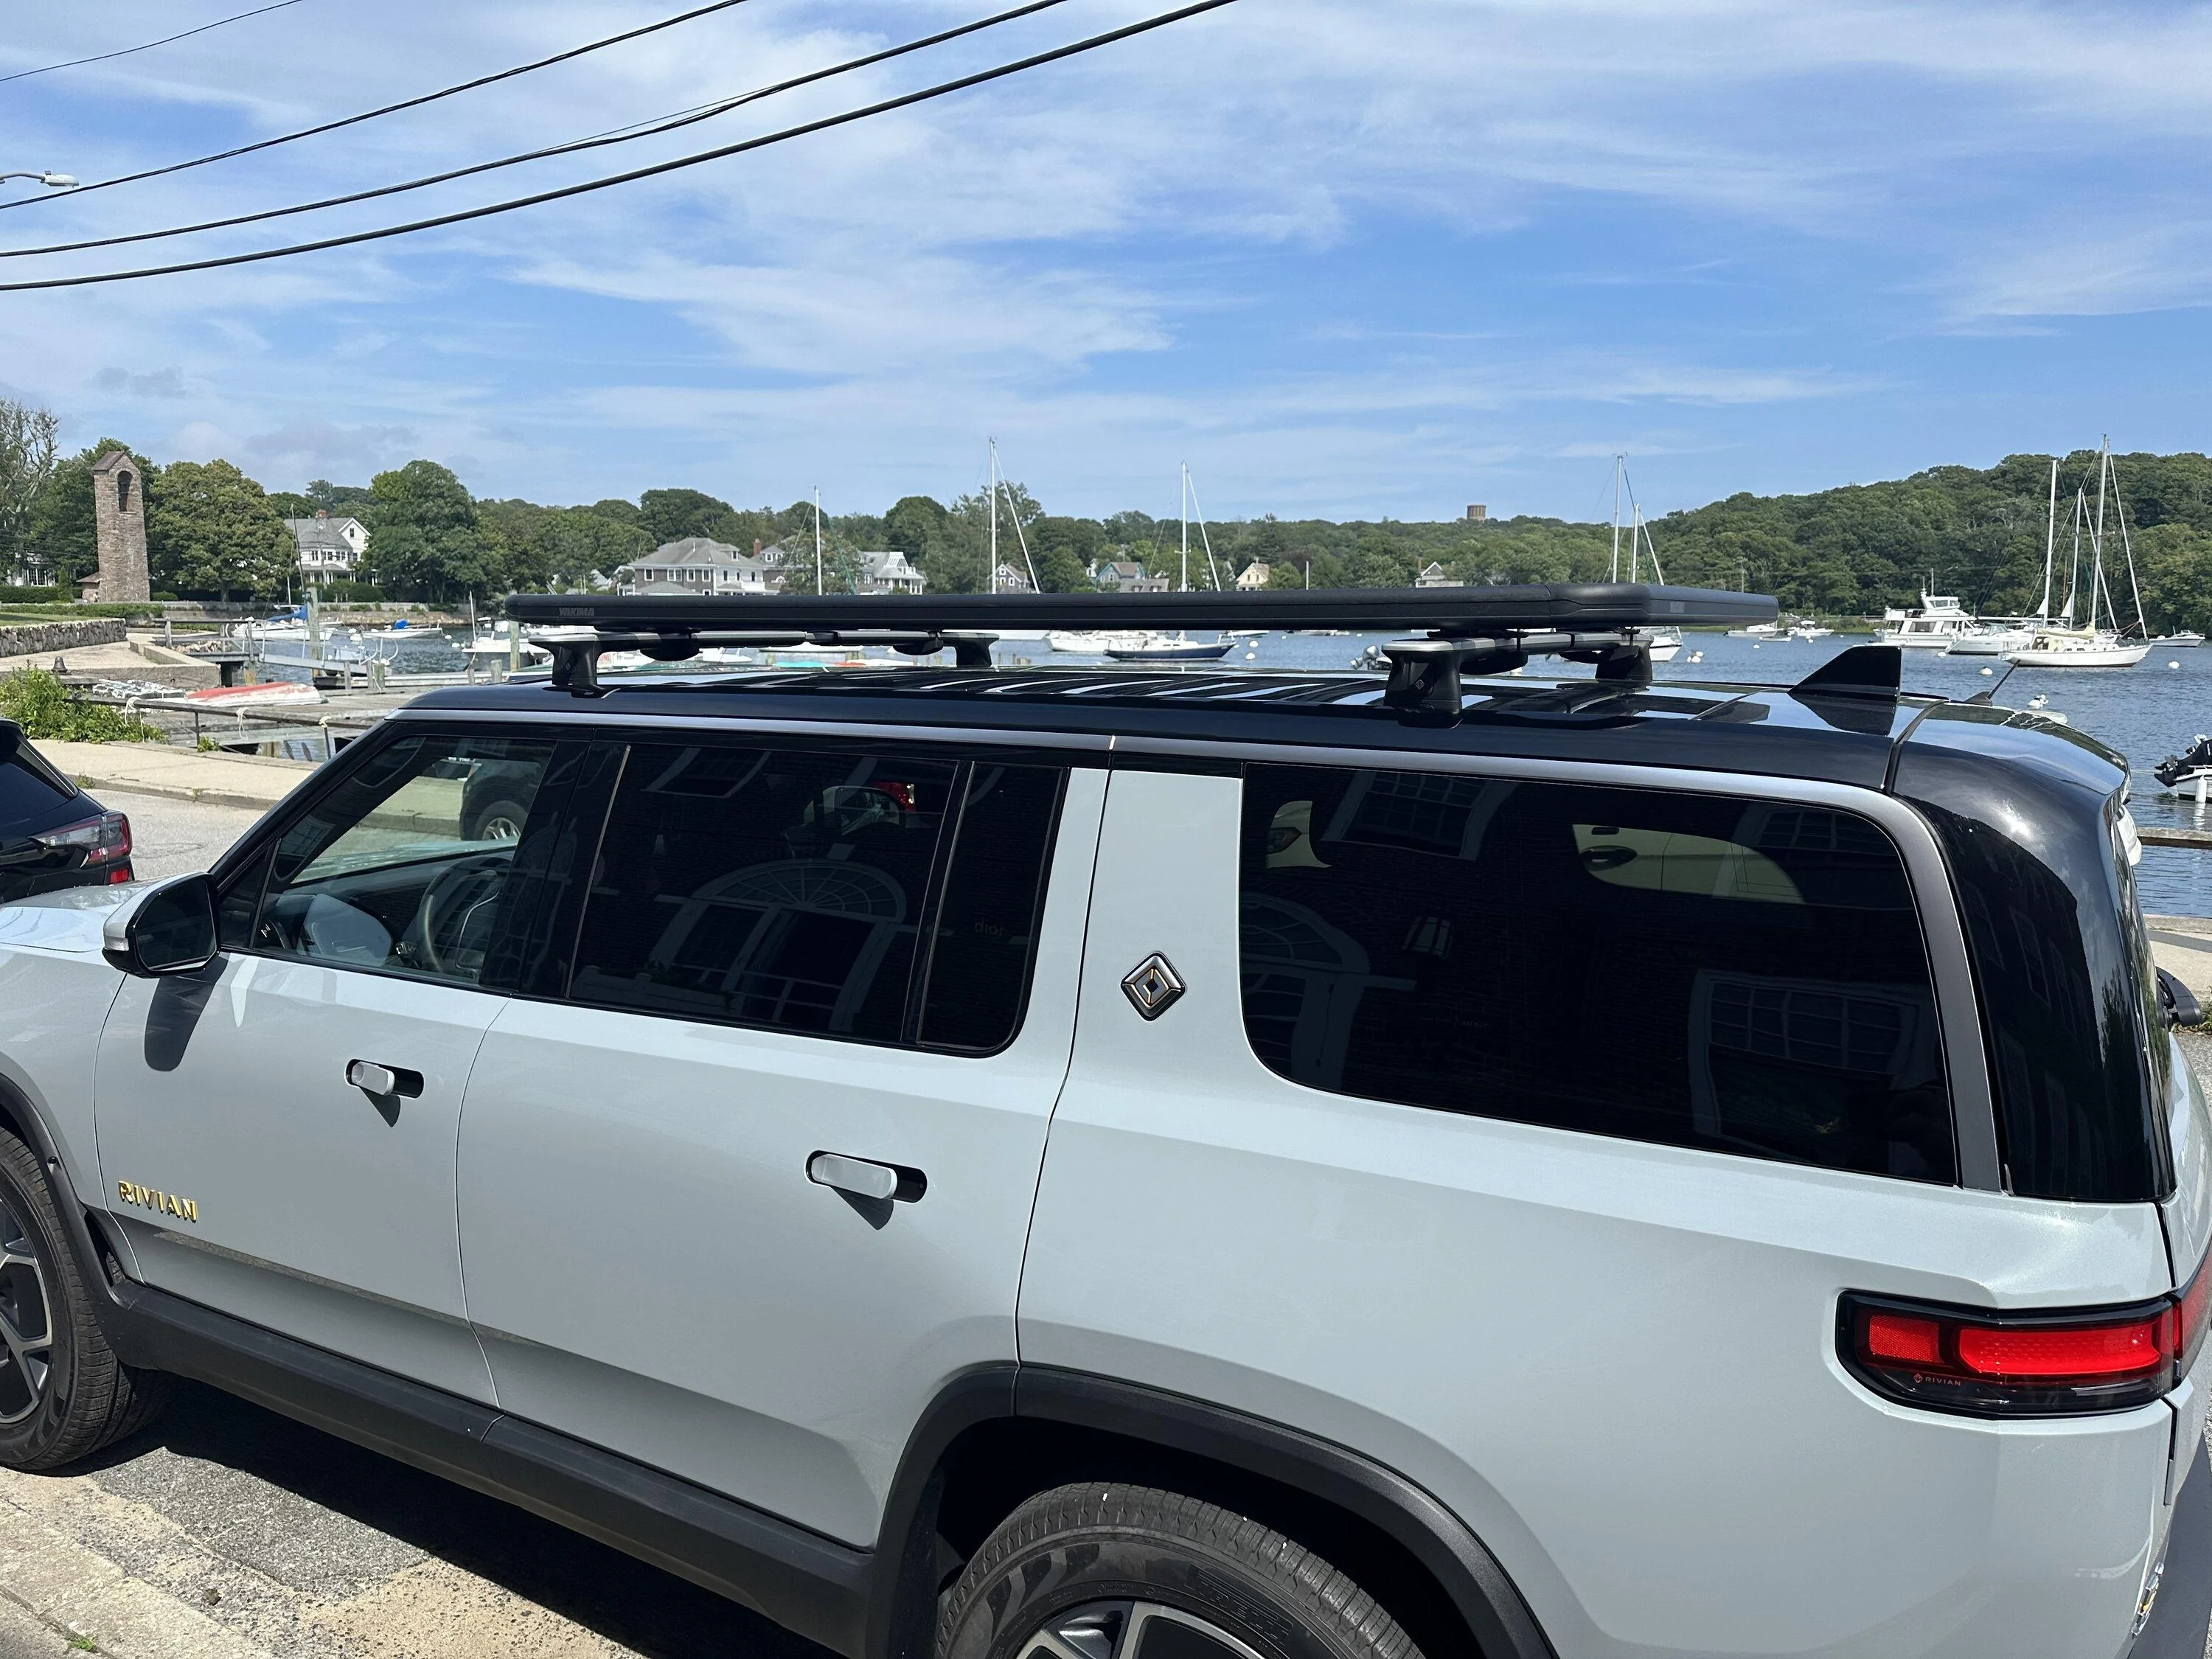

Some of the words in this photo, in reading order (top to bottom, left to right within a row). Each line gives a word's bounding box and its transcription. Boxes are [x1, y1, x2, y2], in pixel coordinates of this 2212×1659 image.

[558, 607, 595, 616] YAKIMA
[118, 1180, 198, 1224] RIVIAN
[1924, 1376, 1961, 1387] RIVIAN
